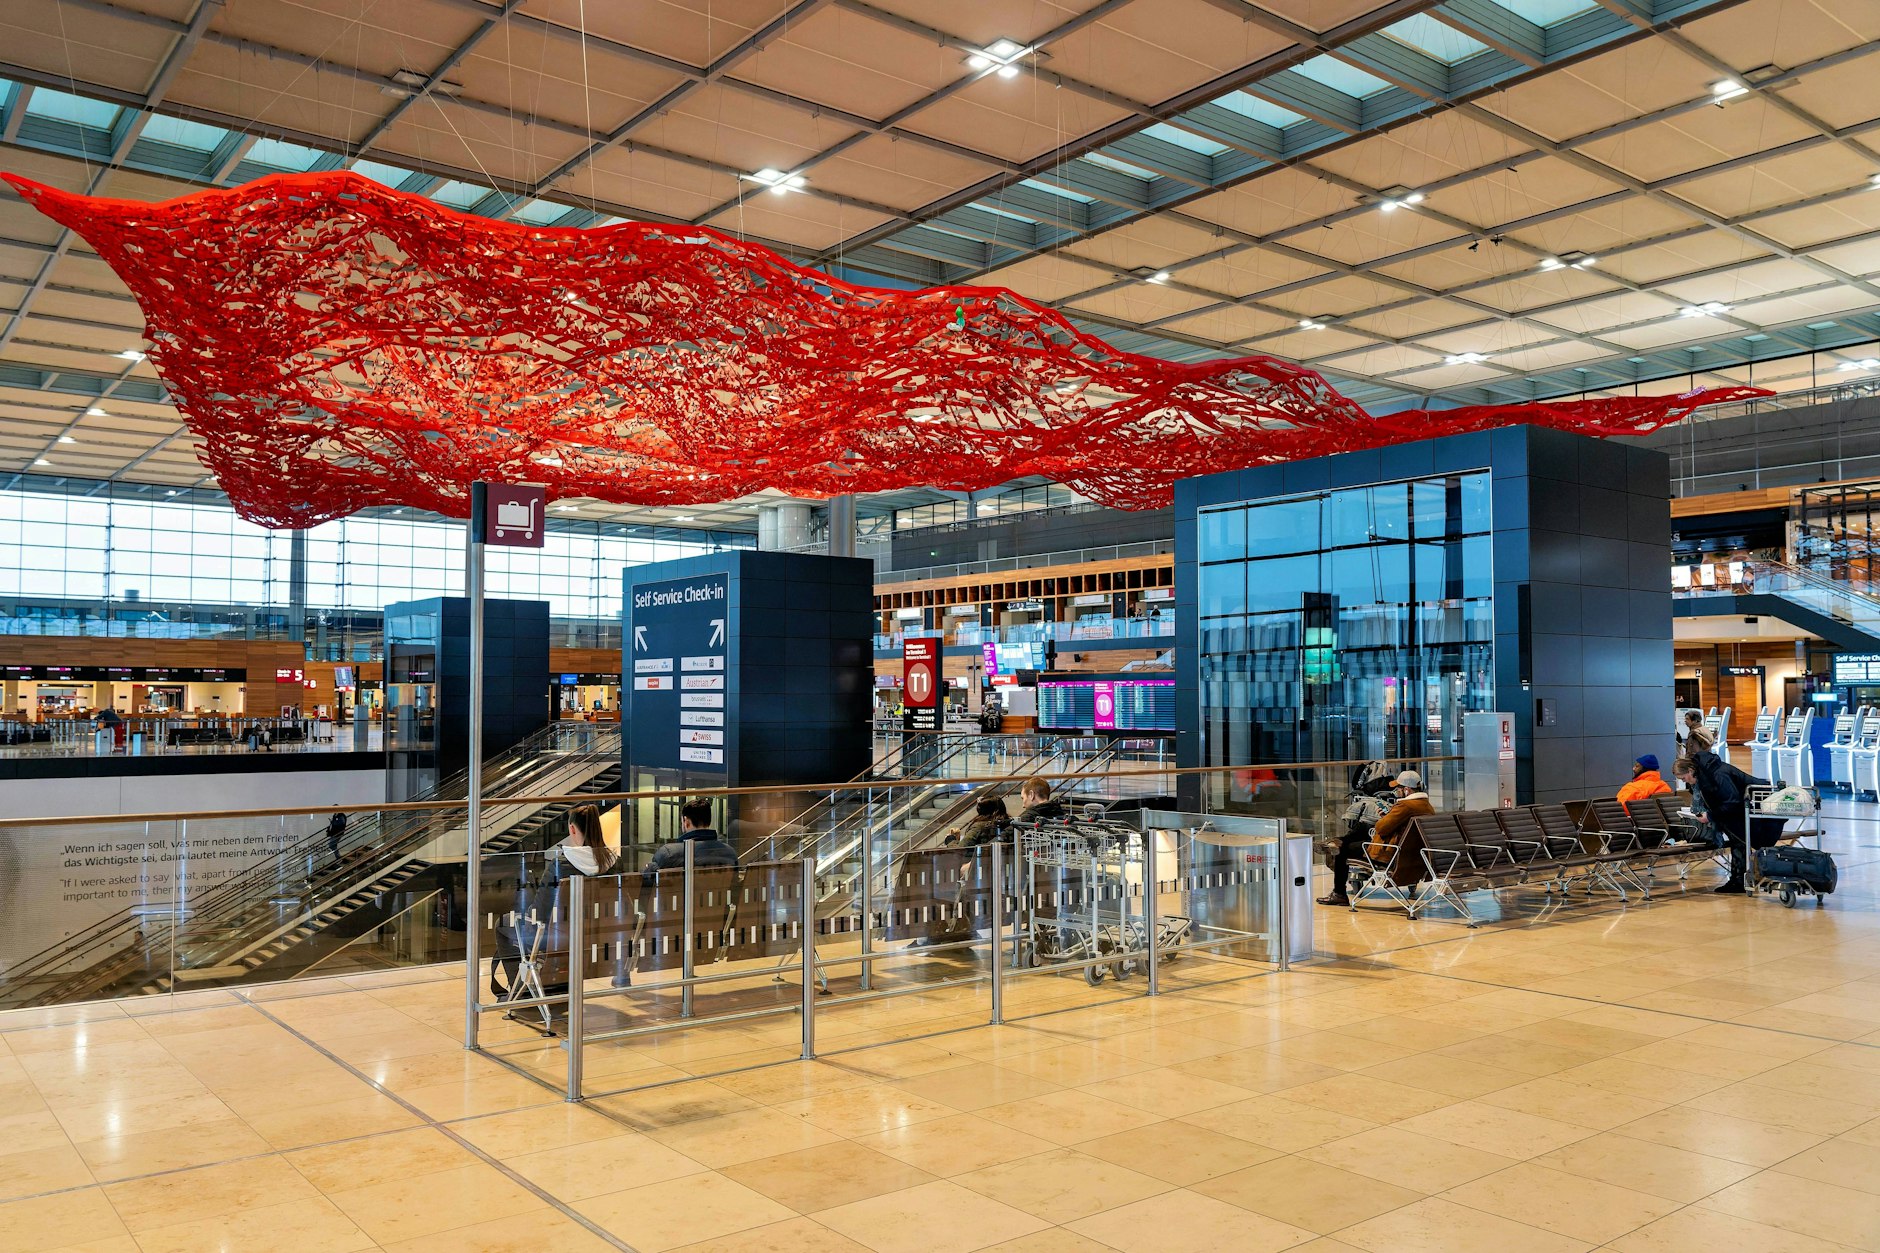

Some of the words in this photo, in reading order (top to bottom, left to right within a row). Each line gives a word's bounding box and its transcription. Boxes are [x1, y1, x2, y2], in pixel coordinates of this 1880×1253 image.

[635, 590, 651, 608] Self
[652, 588, 683, 606] Service
[684, 582, 724, 602] Check-in
[1848, 654, 1871, 662] Service
[294, 669, 303, 681] 5
[310, 679, 317, 689] 8
[910, 672, 928, 693] T1
[1098, 699, 1109, 711] T1
[695, 715, 716, 723] Lufthansa
[698, 733, 712, 741] SWISS
[98, 843, 113, 852] ich
[115, 841, 145, 853] sagen
[148, 840, 168, 850] soll,
[171, 840, 190, 848] was
[192, 838, 209, 847] mir
[211, 837, 241, 846] neben
[243, 835, 264, 845] dem
[266, 833, 299, 843] Frieden
[64, 858, 82, 868] das
[85, 855, 139, 867] Wichtigste
[141, 854, 158, 863] sei,
[187, 850, 217, 860] lautet
[219, 849, 248, 858] meine
[1246, 854, 1263, 864] BER
[74, 878, 77, 887] I
[80, 878, 106, 887] were
[108, 874, 137, 885] asked
[140, 874, 150, 883] to
[153, 873, 170, 884] say
[201, 869, 226, 880] apart
[229, 868, 251, 878] from
[63, 890, 115, 903] important
[118, 889, 128, 898] to
[131, 888, 149, 897] me,
[195, 883, 228, 893] answer
